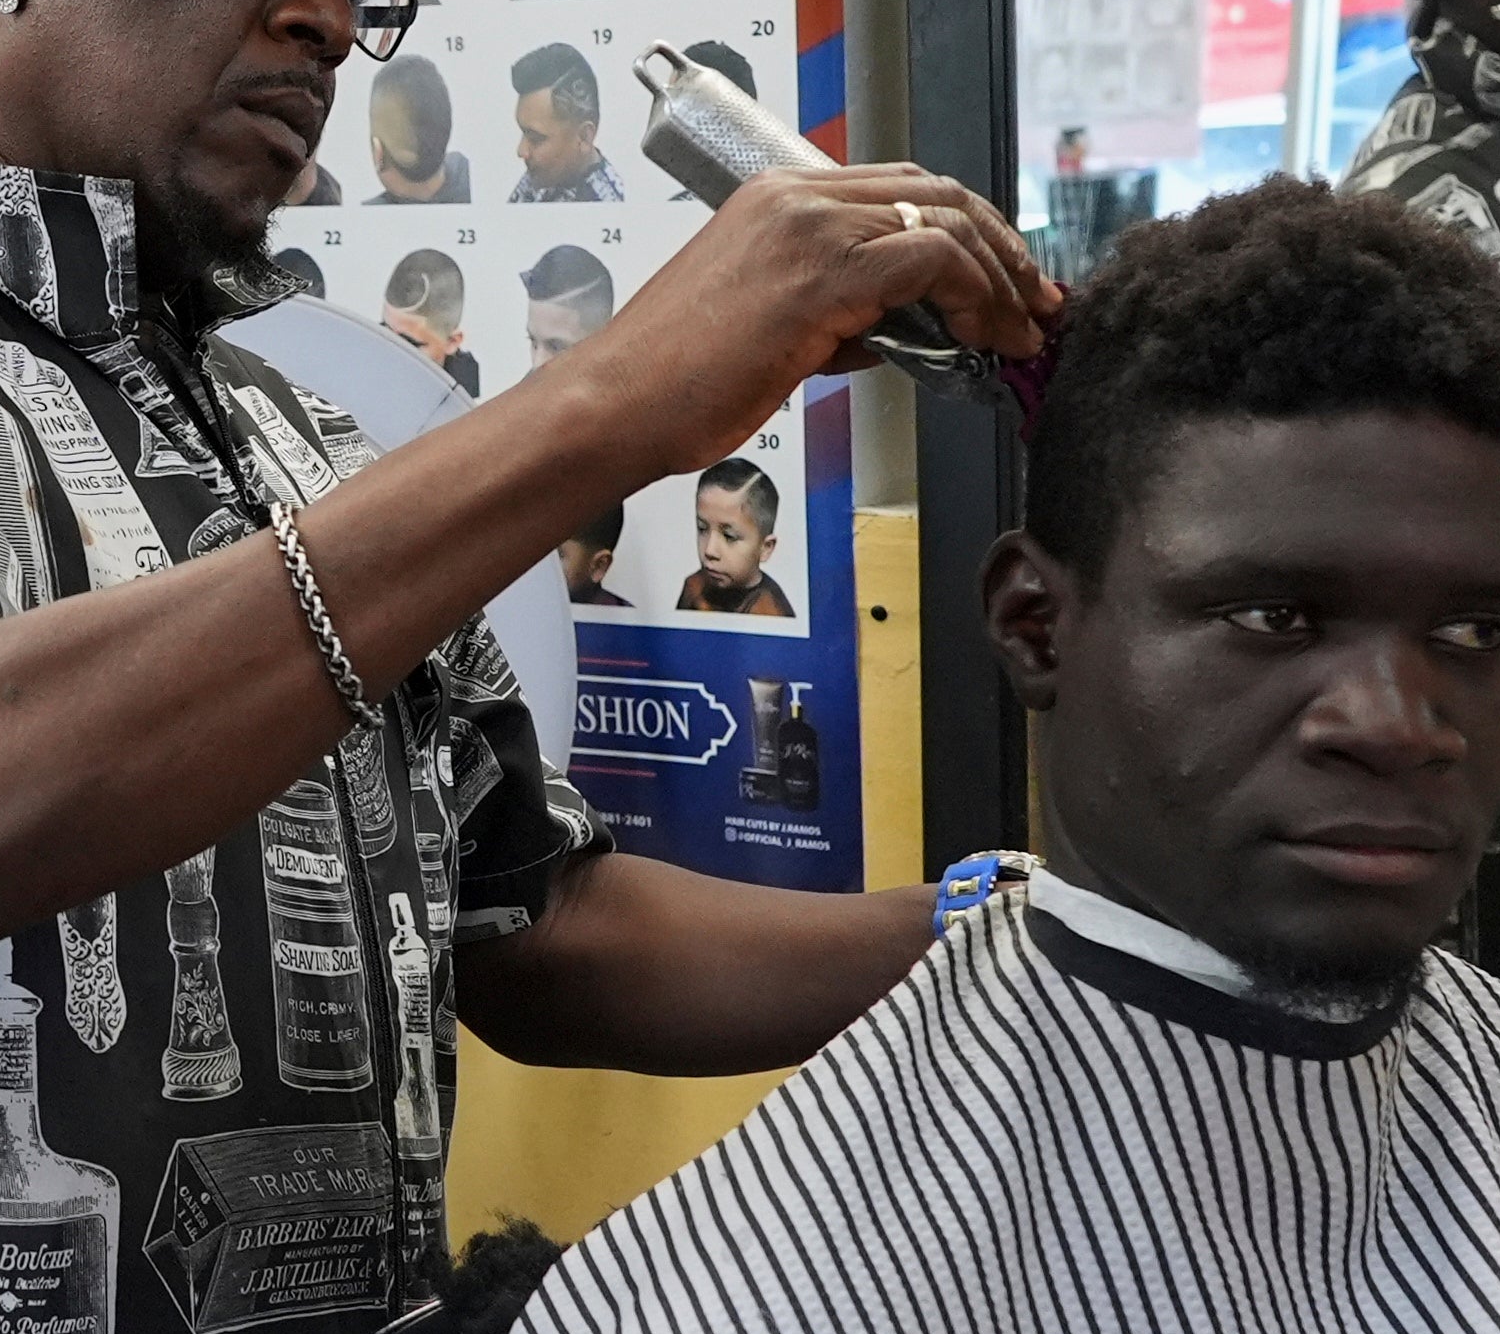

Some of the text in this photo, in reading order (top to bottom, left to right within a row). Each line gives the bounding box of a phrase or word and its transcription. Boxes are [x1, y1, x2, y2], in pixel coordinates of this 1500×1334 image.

[593, 28, 613, 45] 19
[751, 19, 775, 37] 20
[445, 35, 465, 52] 18
[324, 230, 342, 246] 22
[457, 229, 476, 246] 23
[602, 228, 622, 245] 24
[757, 433, 780, 450] 30
[573, 693, 690, 741] SHION
[262, 817, 312, 843] COLGATE
[746, 818, 767, 830] CUTS
[768, 822, 780, 832] BY
[286, 1025, 321, 1042] CLOSE
[293, 1147, 337, 1164] OUR
[250, 1170, 325, 1198] TRADE
[332, 1216, 374, 1239] BAR
[349, 1243, 364, 1254] BY
